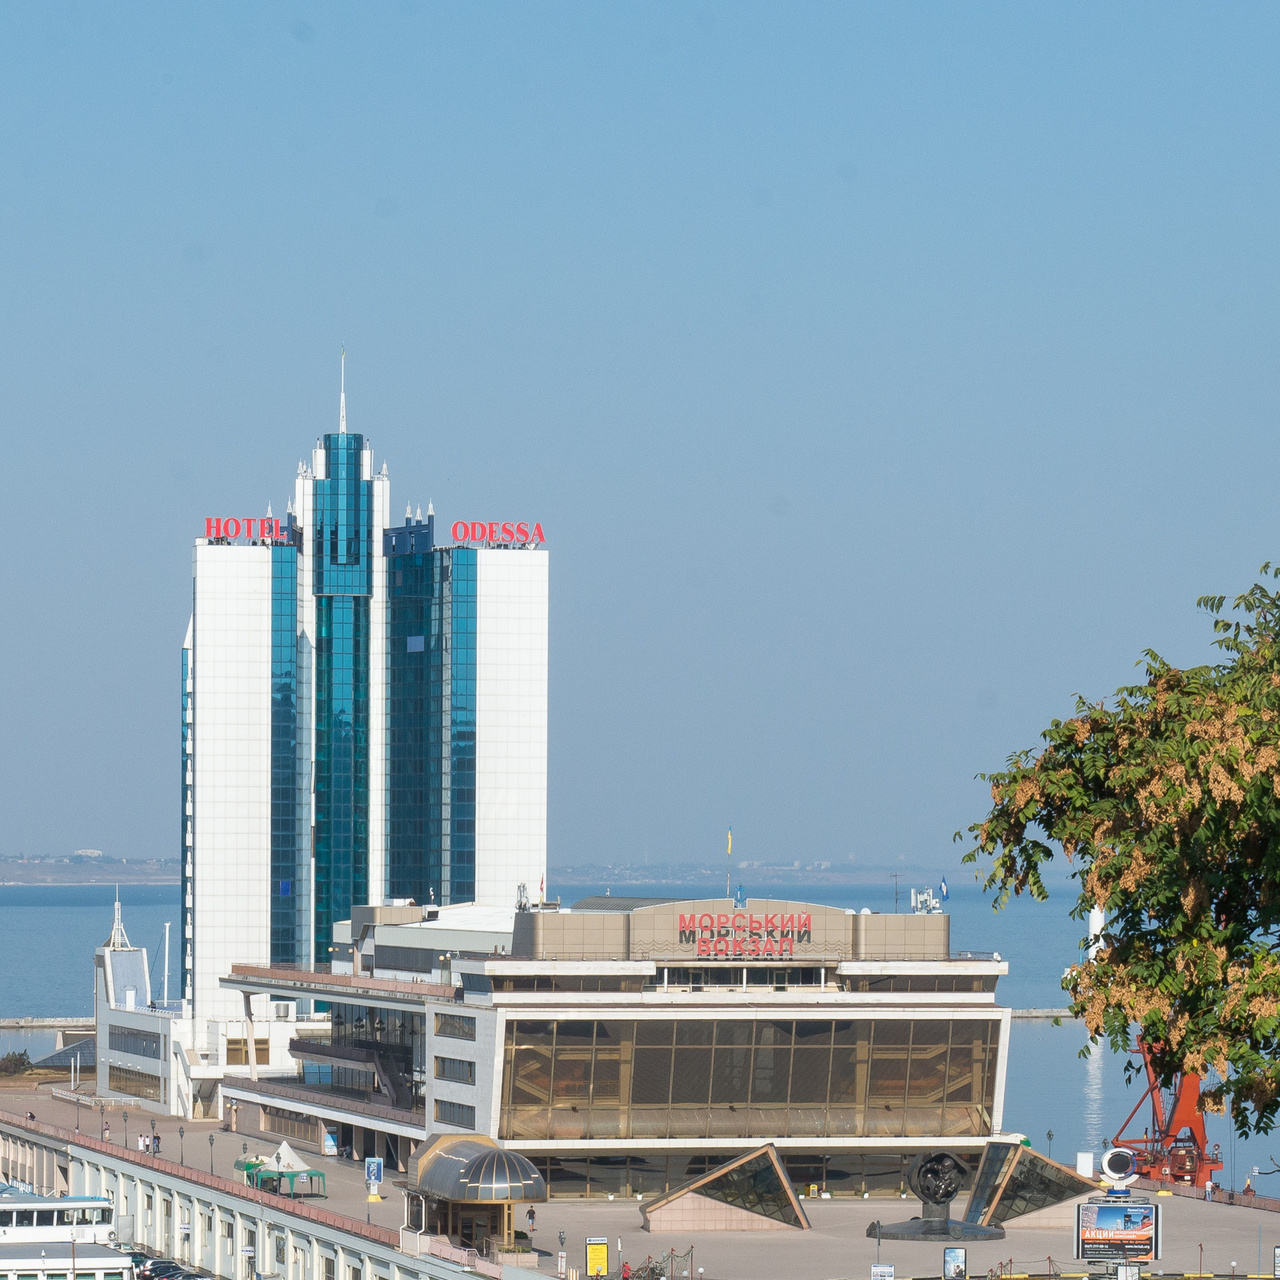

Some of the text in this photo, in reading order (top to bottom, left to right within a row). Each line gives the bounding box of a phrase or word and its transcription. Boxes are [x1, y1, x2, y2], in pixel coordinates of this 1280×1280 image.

[205, 517, 546, 543] HOTEL ODESSA
[679, 911, 811, 931] МОРСЬКИЙ
[697, 937, 793, 955] ВОКЗАЛ
[1084, 1231, 1114, 1239] АКЦИИ
